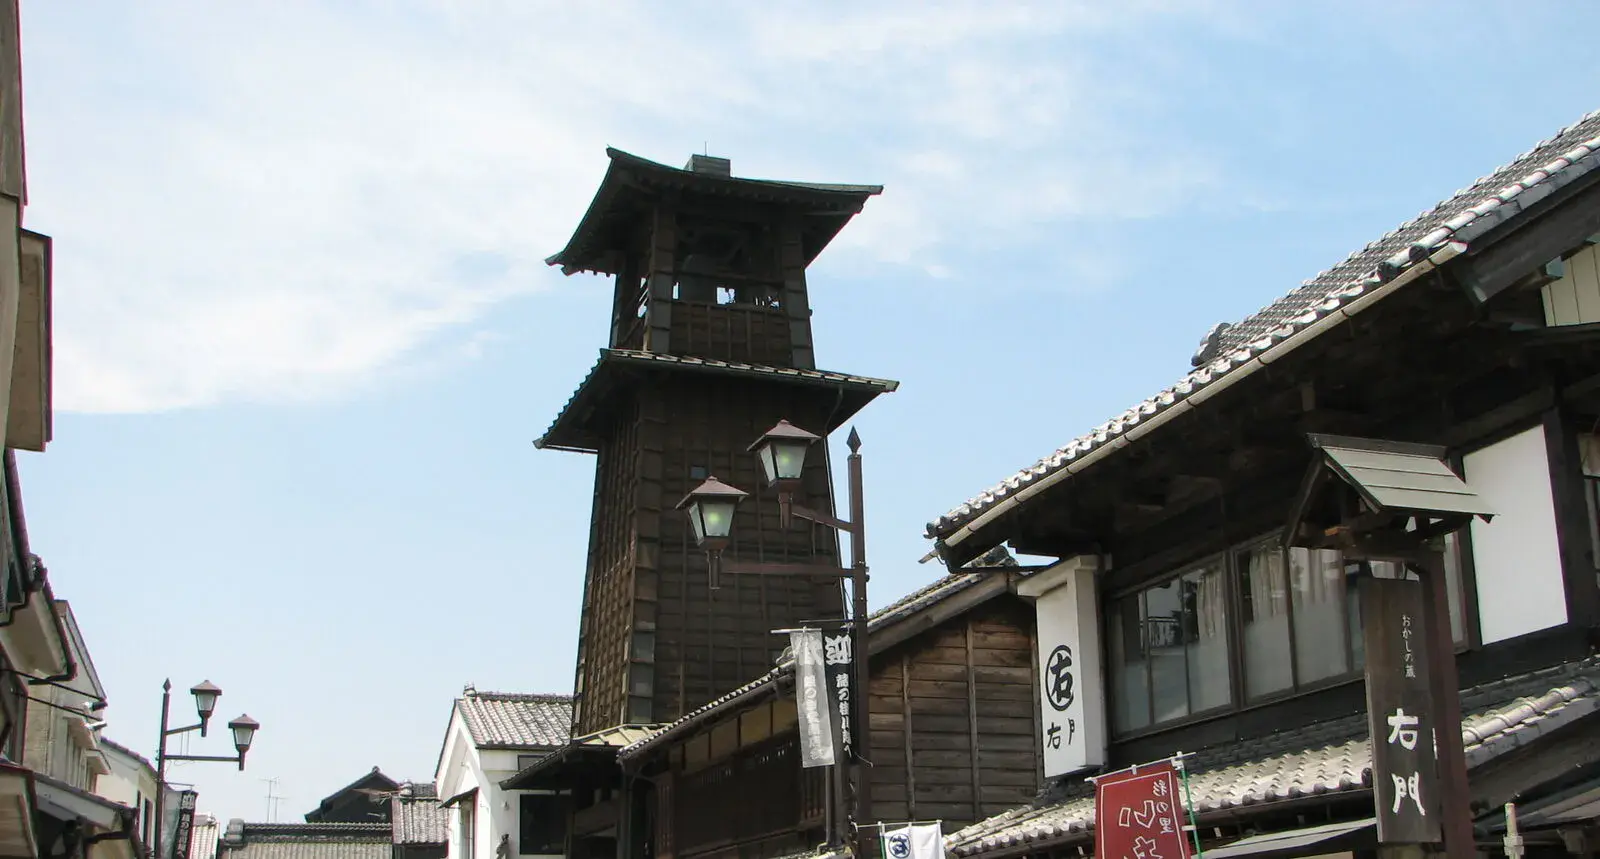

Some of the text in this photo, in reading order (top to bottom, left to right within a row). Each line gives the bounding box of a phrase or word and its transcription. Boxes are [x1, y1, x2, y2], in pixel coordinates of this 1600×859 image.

[1402, 614, 1416, 678] おかしの蔵
[1387, 708, 1426, 816] 右門
